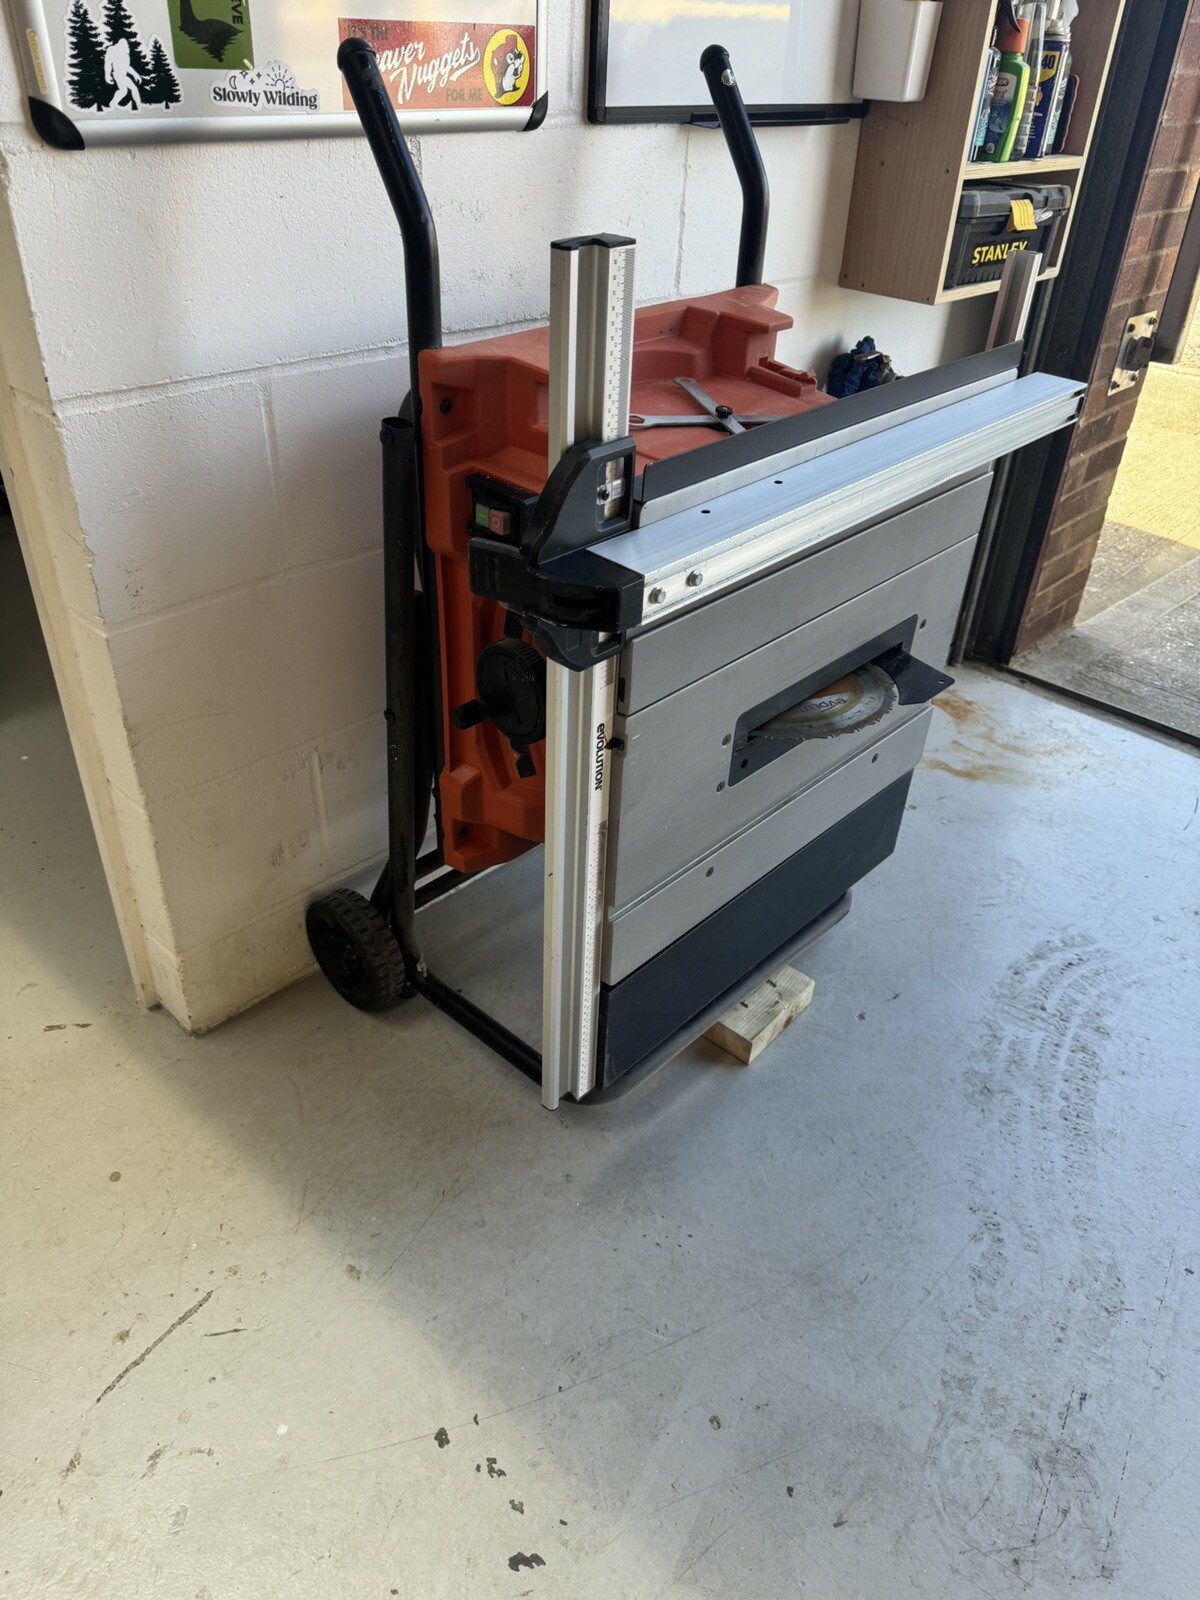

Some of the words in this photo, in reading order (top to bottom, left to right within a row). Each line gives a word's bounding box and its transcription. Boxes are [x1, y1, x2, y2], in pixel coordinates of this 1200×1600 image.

[372, 41, 426, 72] eaver
[389, 32, 481, 105] Nuggets
[213, 86, 260, 107] Slowly
[263, 90, 318, 110] Wilding
[445, 88, 464, 101] FOR
[468, 88, 483, 101] ME
